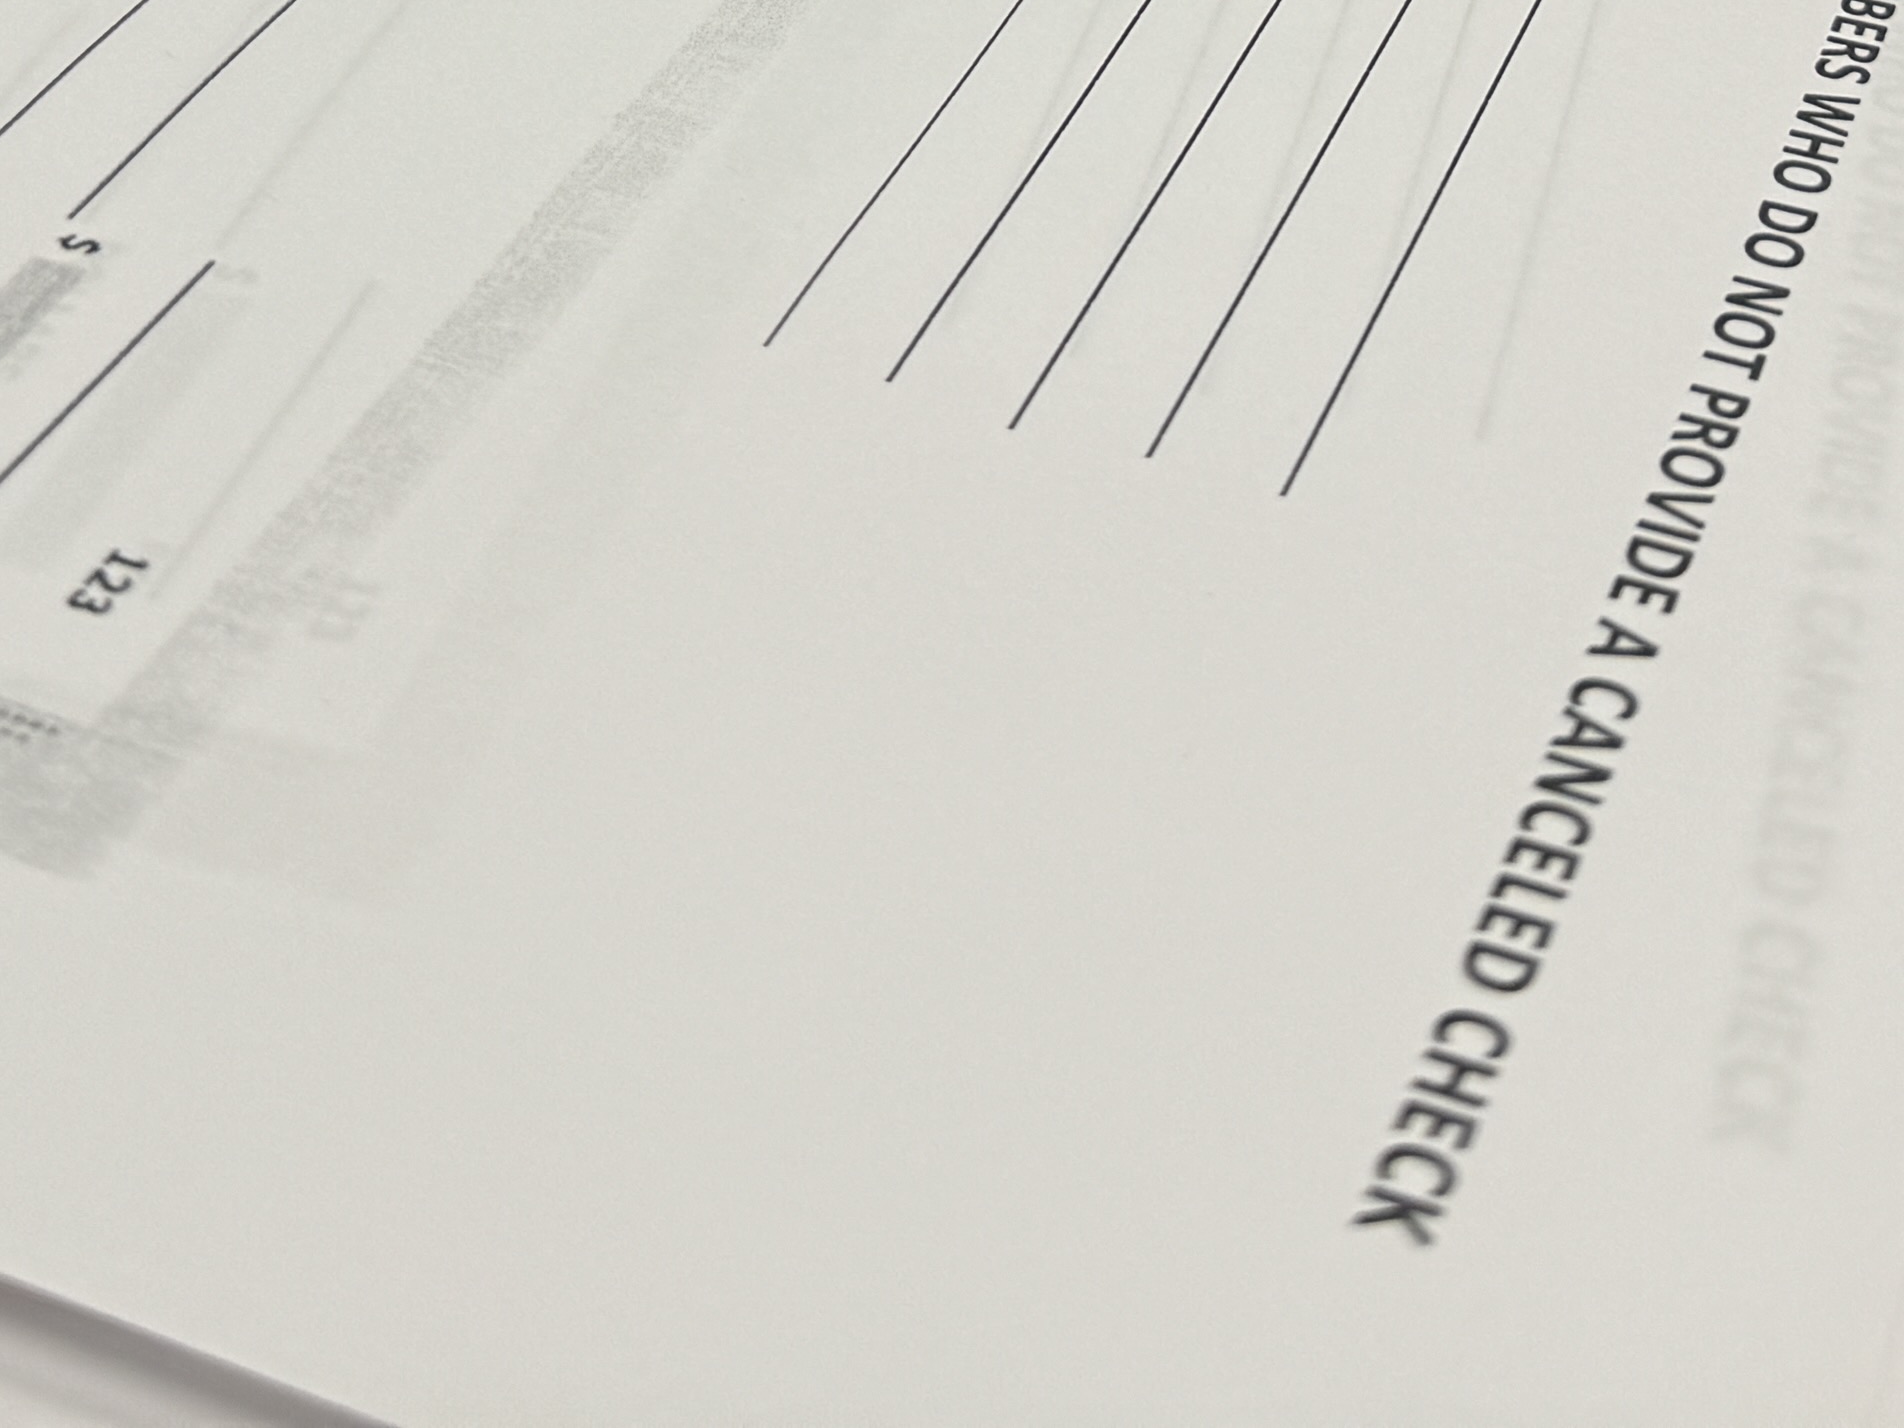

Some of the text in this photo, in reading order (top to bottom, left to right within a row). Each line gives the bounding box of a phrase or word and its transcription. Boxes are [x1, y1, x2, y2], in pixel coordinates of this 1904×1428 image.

[1773, 93, 1861, 193] WHO
[57, 232, 102, 256] $
[1744, 199, 1819, 268] DO
[1702, 275, 1792, 381] NOT
[1608, 383, 1751, 615] PROVIDE
[66, 547, 151, 617] 123
[1585, 617, 1660, 658] A
[1461, 671, 1641, 993] CANCELED
[1347, 1008, 1514, 1248] CHECK
